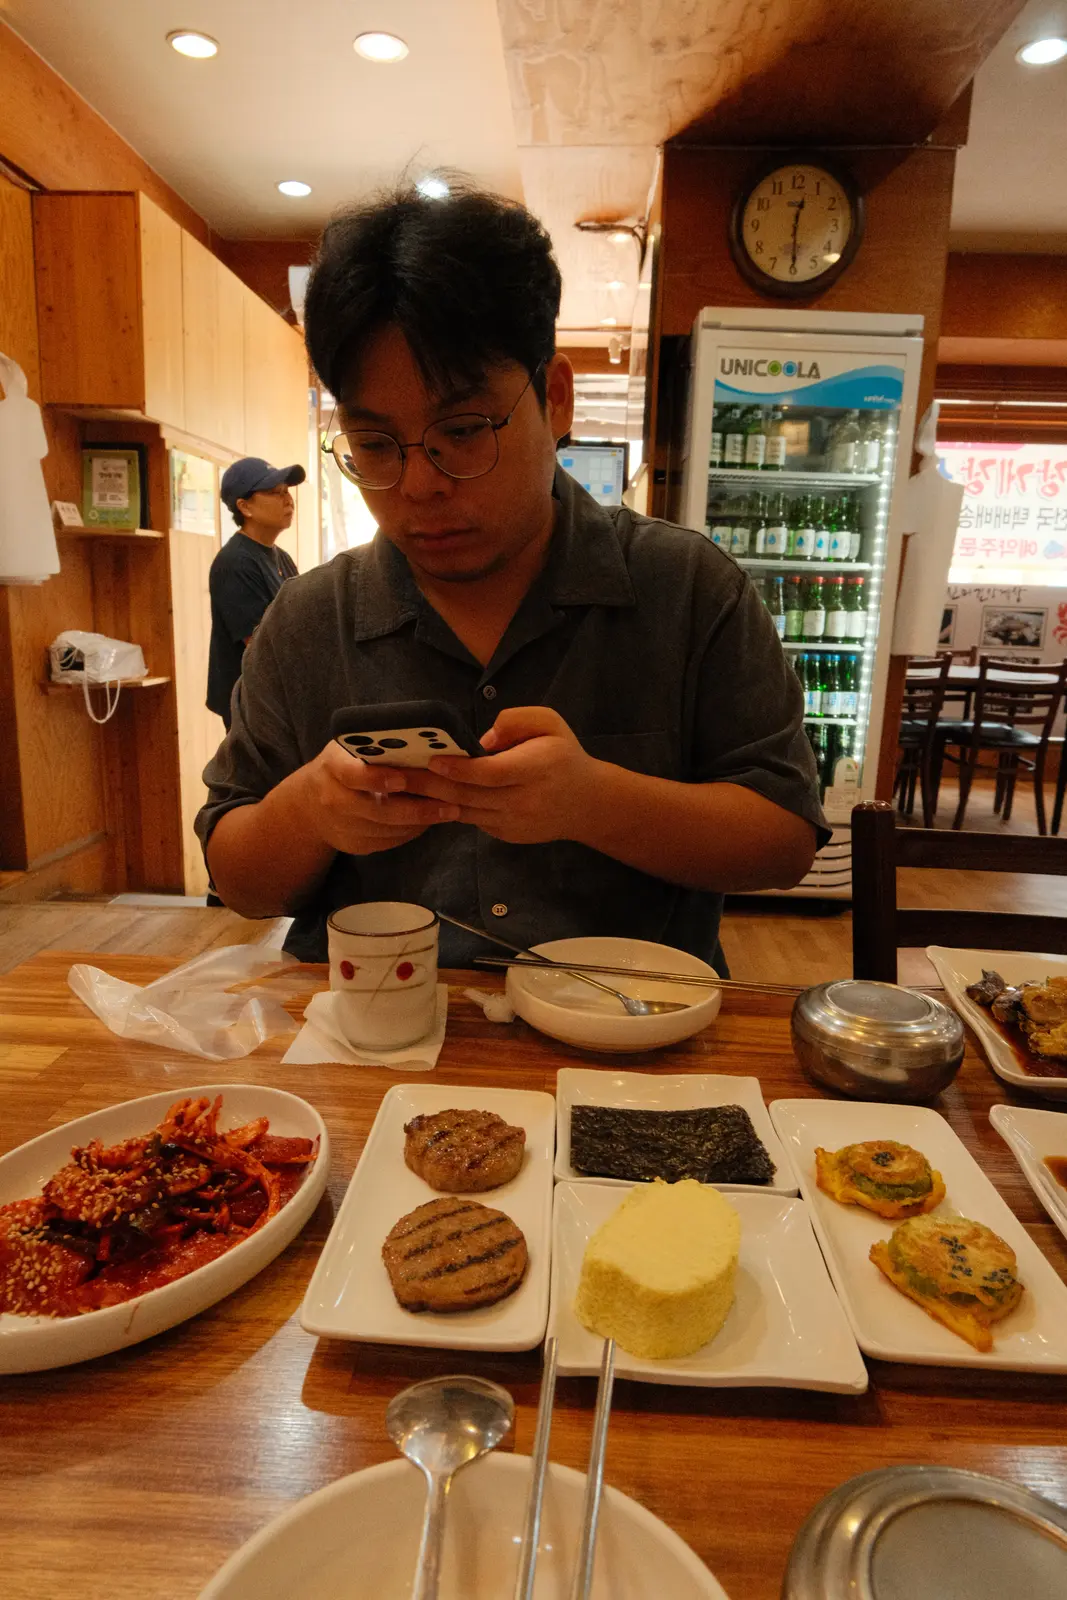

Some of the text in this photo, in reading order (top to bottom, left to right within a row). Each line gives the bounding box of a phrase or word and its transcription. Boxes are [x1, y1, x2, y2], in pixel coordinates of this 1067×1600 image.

[772, 181, 783, 195] 11
[791, 174, 805, 190] 12
[815, 181, 821, 196] 1
[757, 197, 770, 211] 10
[827, 197, 836, 210] 2
[751, 218, 760, 232] 9
[830, 218, 839, 233] 3
[755, 240, 764, 254] 8
[823, 240, 832, 253] 4
[768, 256, 777, 270] 7
[789, 262, 797, 275] 6
[809, 255, 818, 269] 5
[720, 358, 821, 379] UNICOOLA
